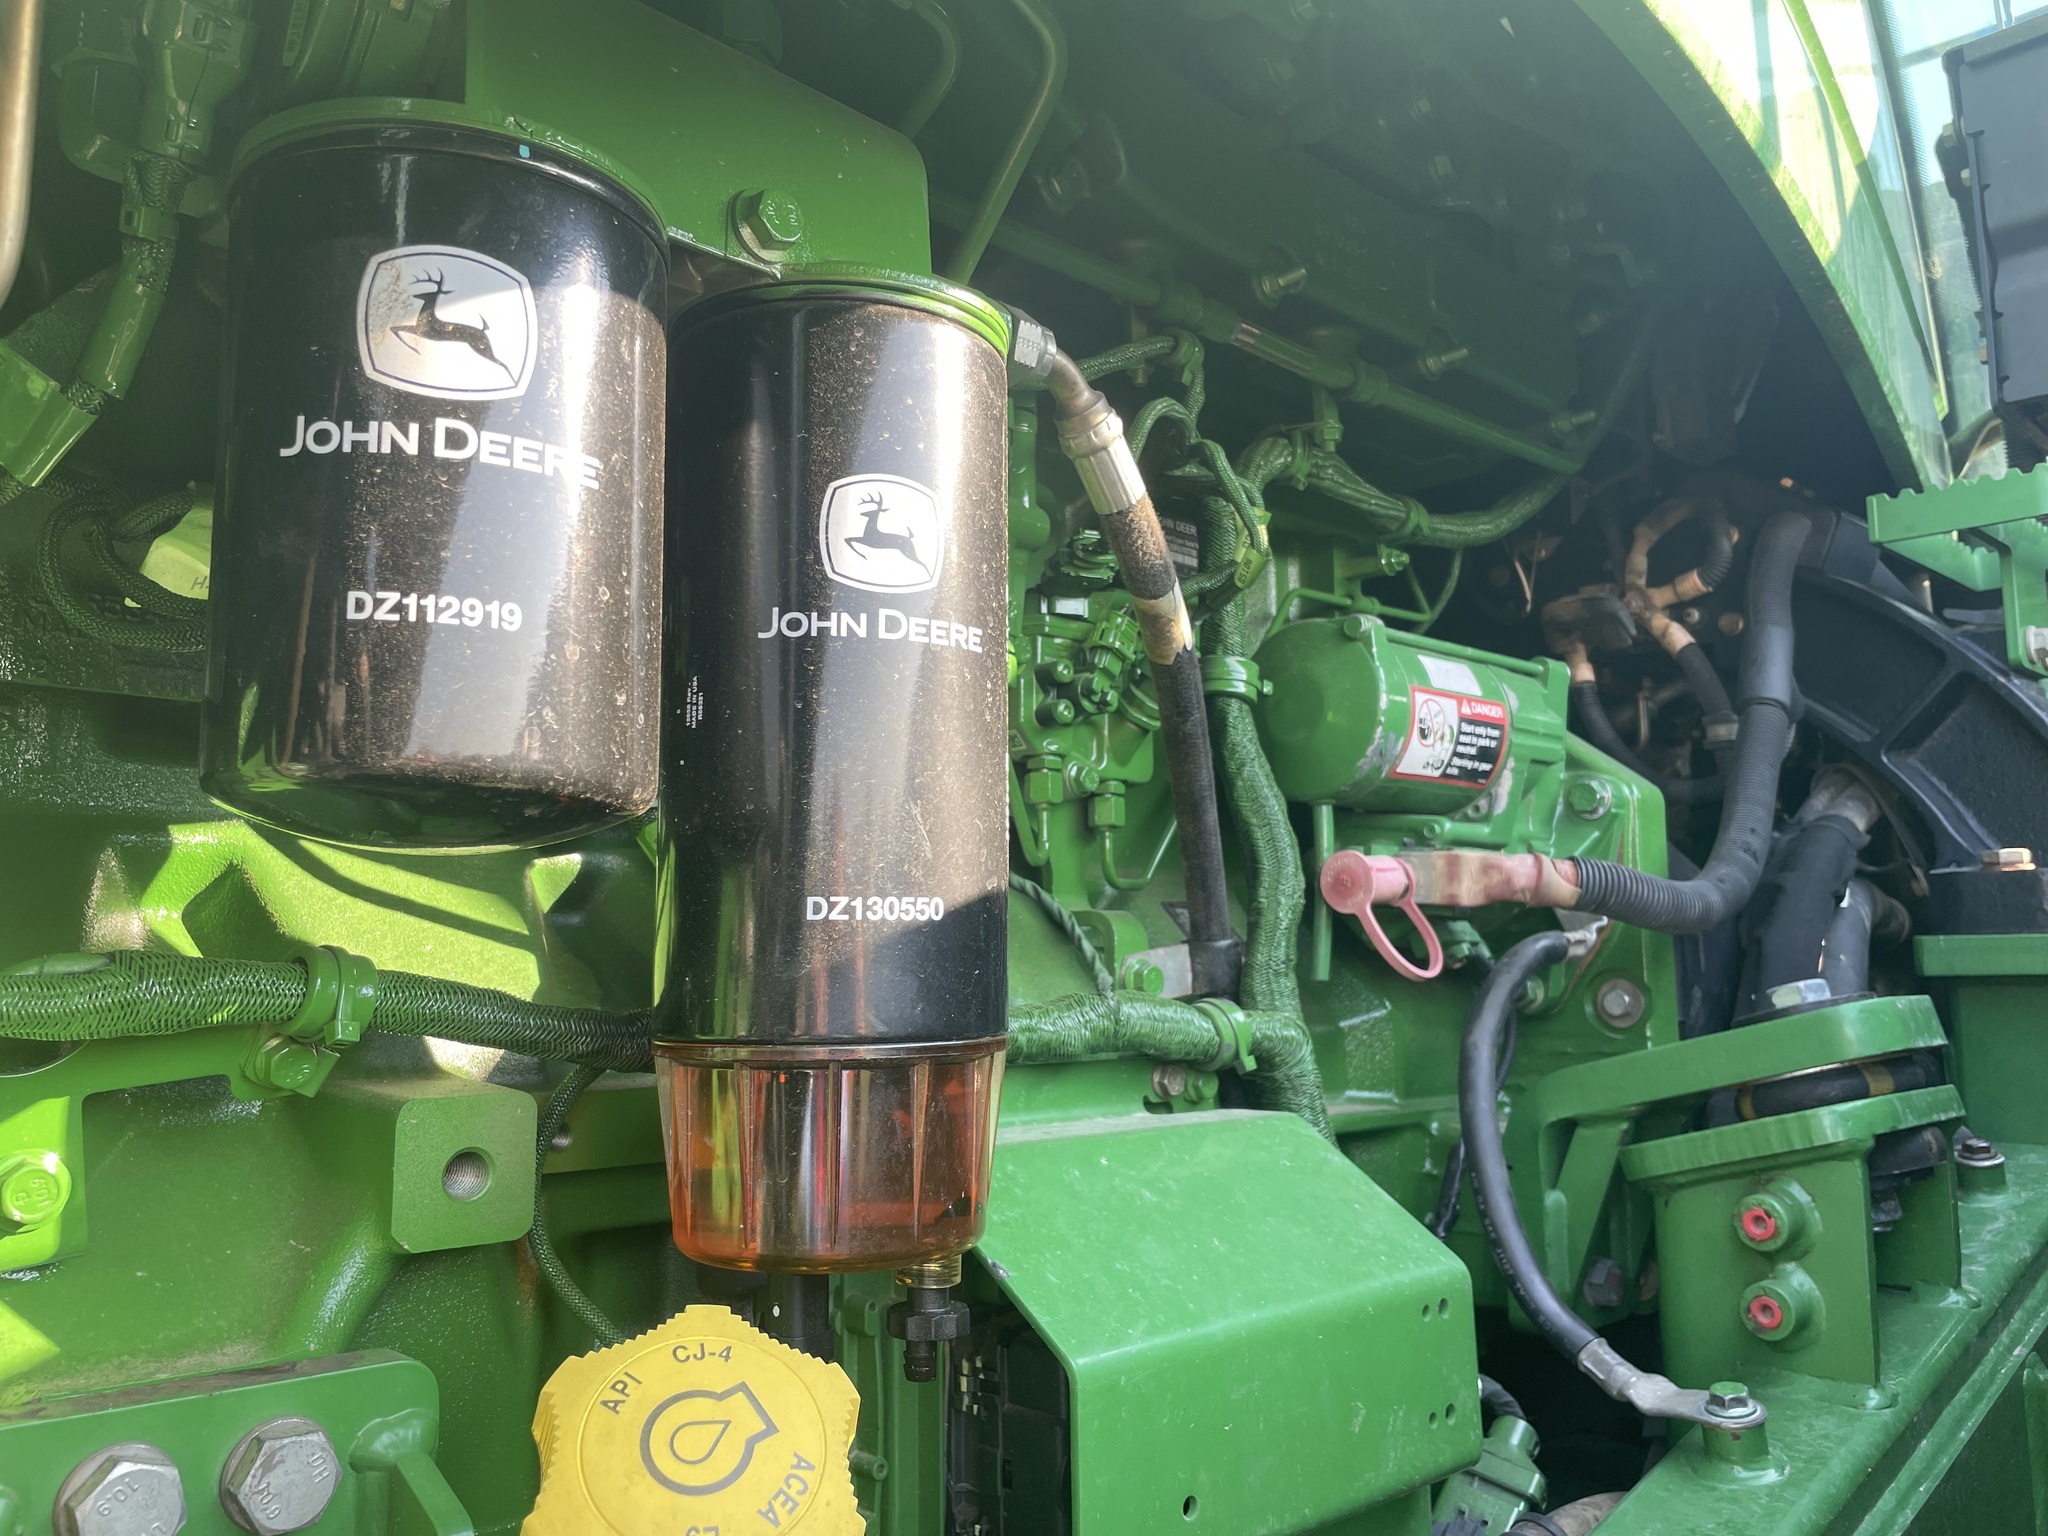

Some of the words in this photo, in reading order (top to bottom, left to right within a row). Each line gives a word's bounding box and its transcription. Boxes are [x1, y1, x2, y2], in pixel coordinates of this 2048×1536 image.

[279, 415, 420, 457] JOHN
[433, 416, 602, 491] DEERE
[346, 590, 523, 632] DZ112919
[757, 606, 868, 639] JOHN
[878, 607, 983, 654] DEERE
[691, 694, 698, 704] IN
[1472, 702, 1503, 718] DANGER
[805, 896, 945, 921] DZ130550
[599, 1370, 644, 1415] API
[671, 1342, 733, 1363] CJ-4
[95, 1476, 140, 1518] 10.9
[757, 1451, 817, 1529] ACEA
